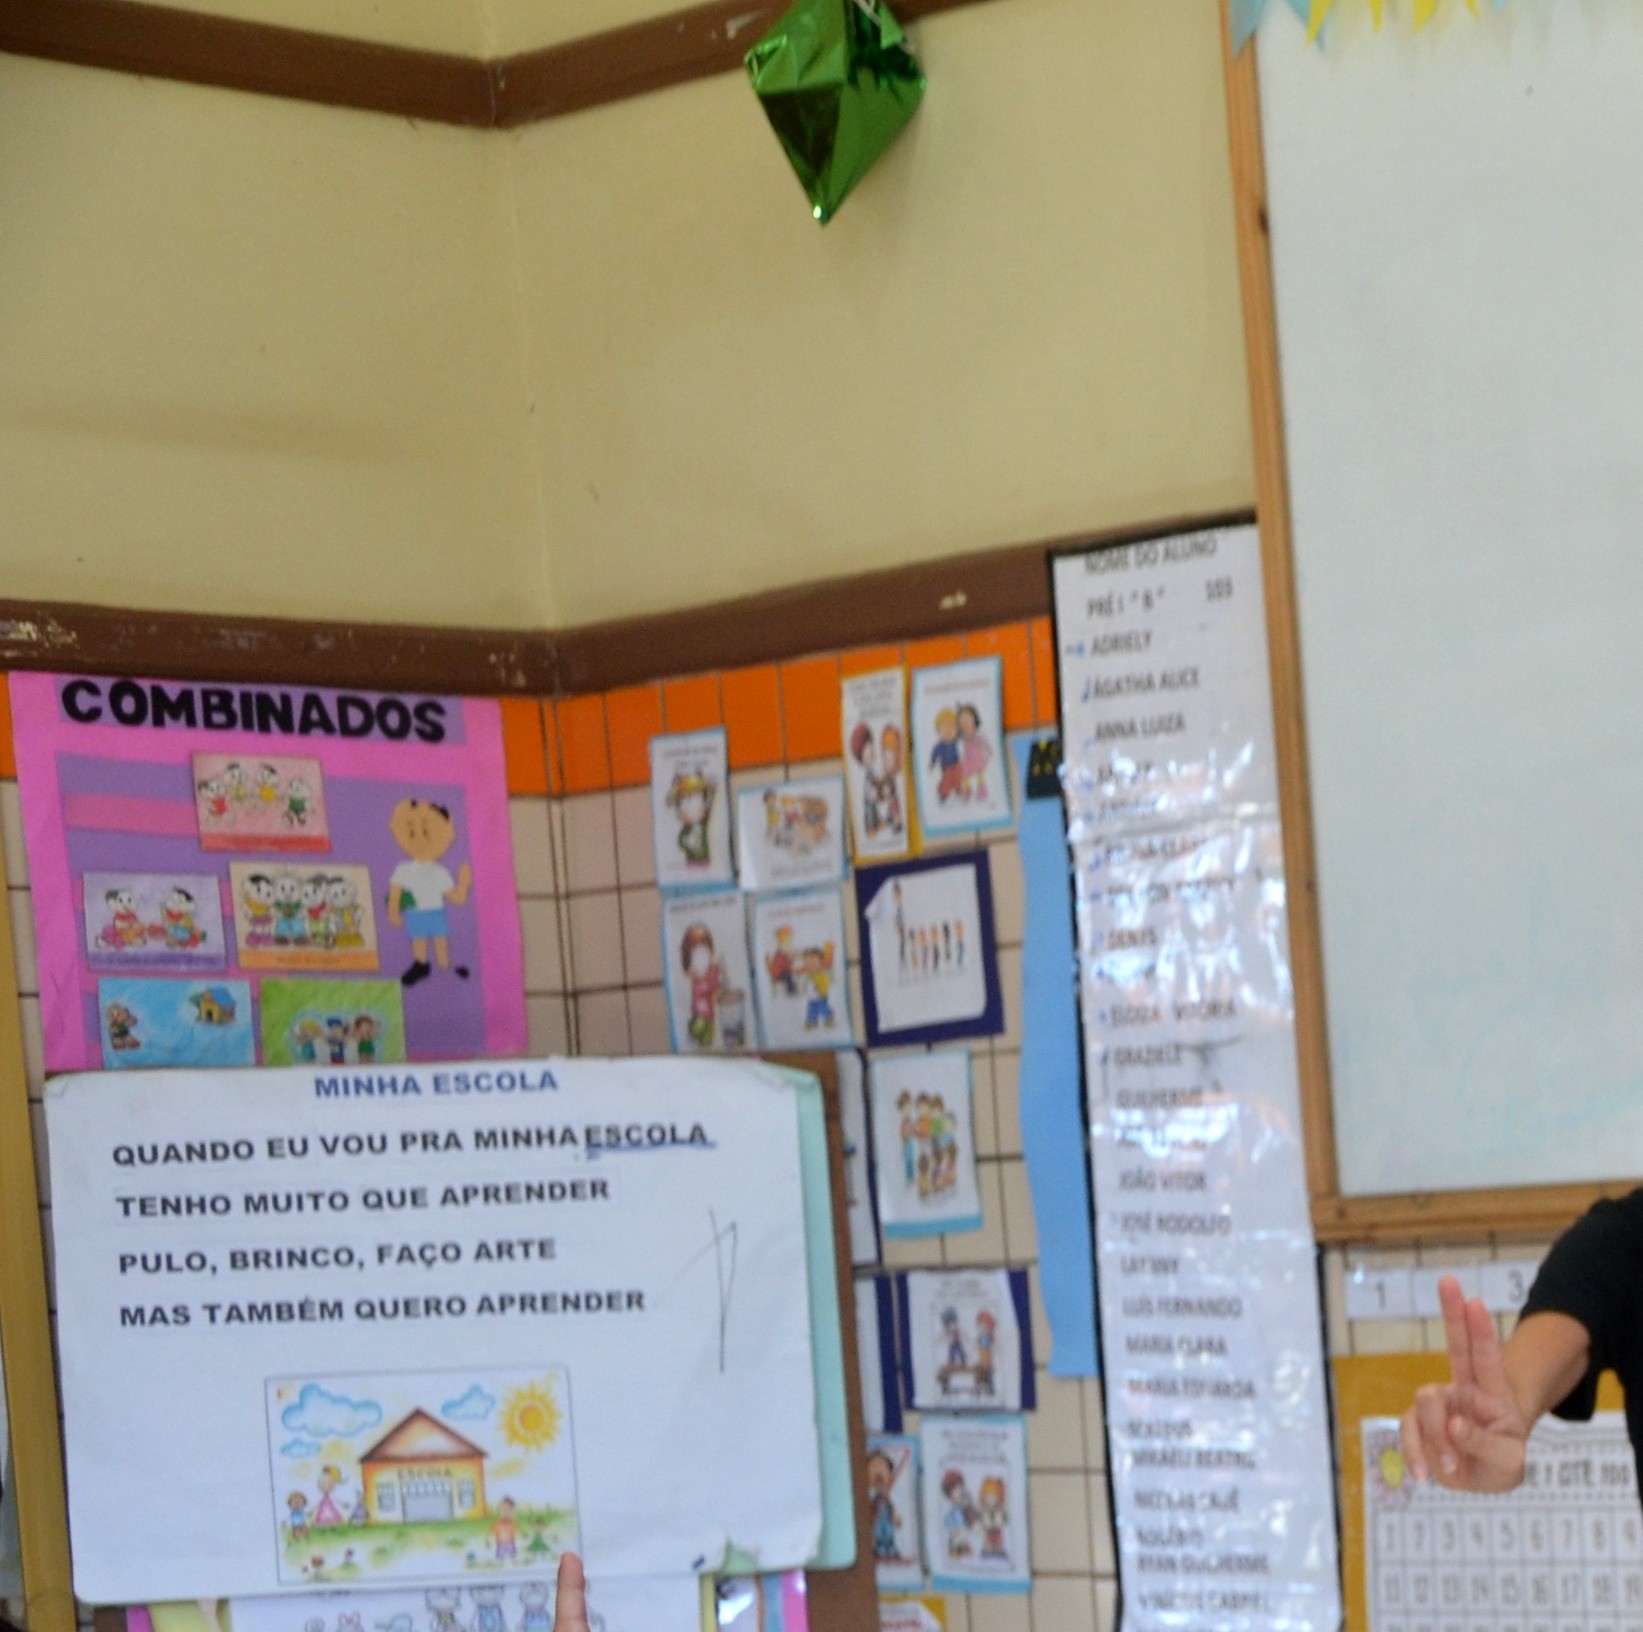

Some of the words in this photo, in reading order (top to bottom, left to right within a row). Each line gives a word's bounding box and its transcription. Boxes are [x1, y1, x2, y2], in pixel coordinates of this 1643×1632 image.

[61, 678, 447, 743] COMBINADOS
[315, 1076, 420, 1096] MINHA
[433, 1071, 557, 1094] ESCOLA
[113, 1141, 254, 1165] QUANDO
[267, 1138, 308, 1157] EU
[320, 1135, 387, 1155] VOU
[401, 1132, 462, 1151] PRA
[475, 1128, 577, 1148] MINHA
[585, 1125, 710, 1152] ESCOLA
[117, 1196, 231, 1216] TENHO
[244, 1192, 349, 1213] MUITO
[363, 1189, 429, 1209] QUE
[441, 1181, 607, 1205] APRENDER
[120, 1253, 216, 1273] PULO,
[230, 1248, 363, 1269] BRINCO,
[377, 1244, 461, 1267] FAÇO
[475, 1240, 557, 1260] ARTE
[121, 1306, 190, 1326] MAS
[203, 1299, 343, 1323] TAMBÉM
[355, 1298, 466, 1319] QUERO
[477, 1293, 643, 1314] APRENDER
